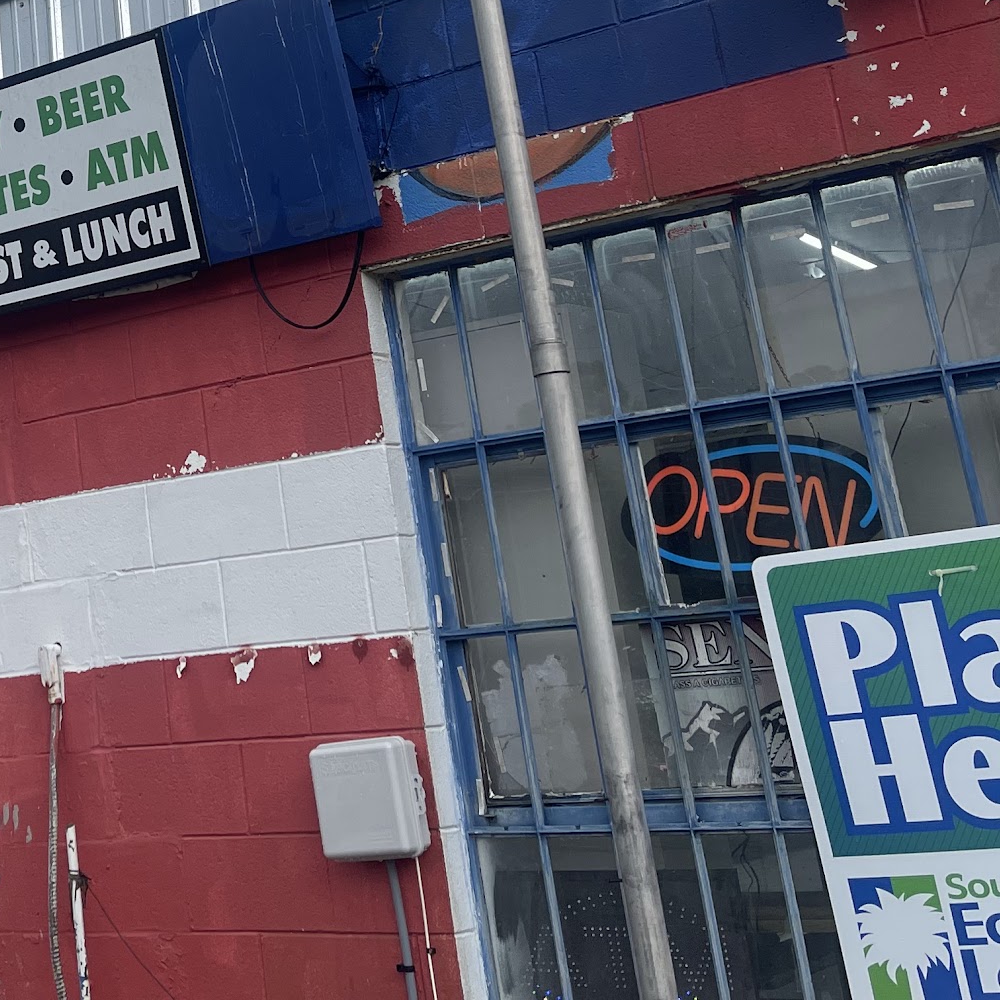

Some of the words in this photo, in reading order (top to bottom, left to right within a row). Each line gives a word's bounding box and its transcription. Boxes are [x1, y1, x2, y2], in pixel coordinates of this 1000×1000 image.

[36, 74, 131, 137] BEER
[87, 130, 170, 192] ATM
[32, 239, 60, 269] &
[61, 201, 176, 267] LUNCH
[647, 465, 857, 550] OPEN
[701, 675, 760, 688] CIGARETS
